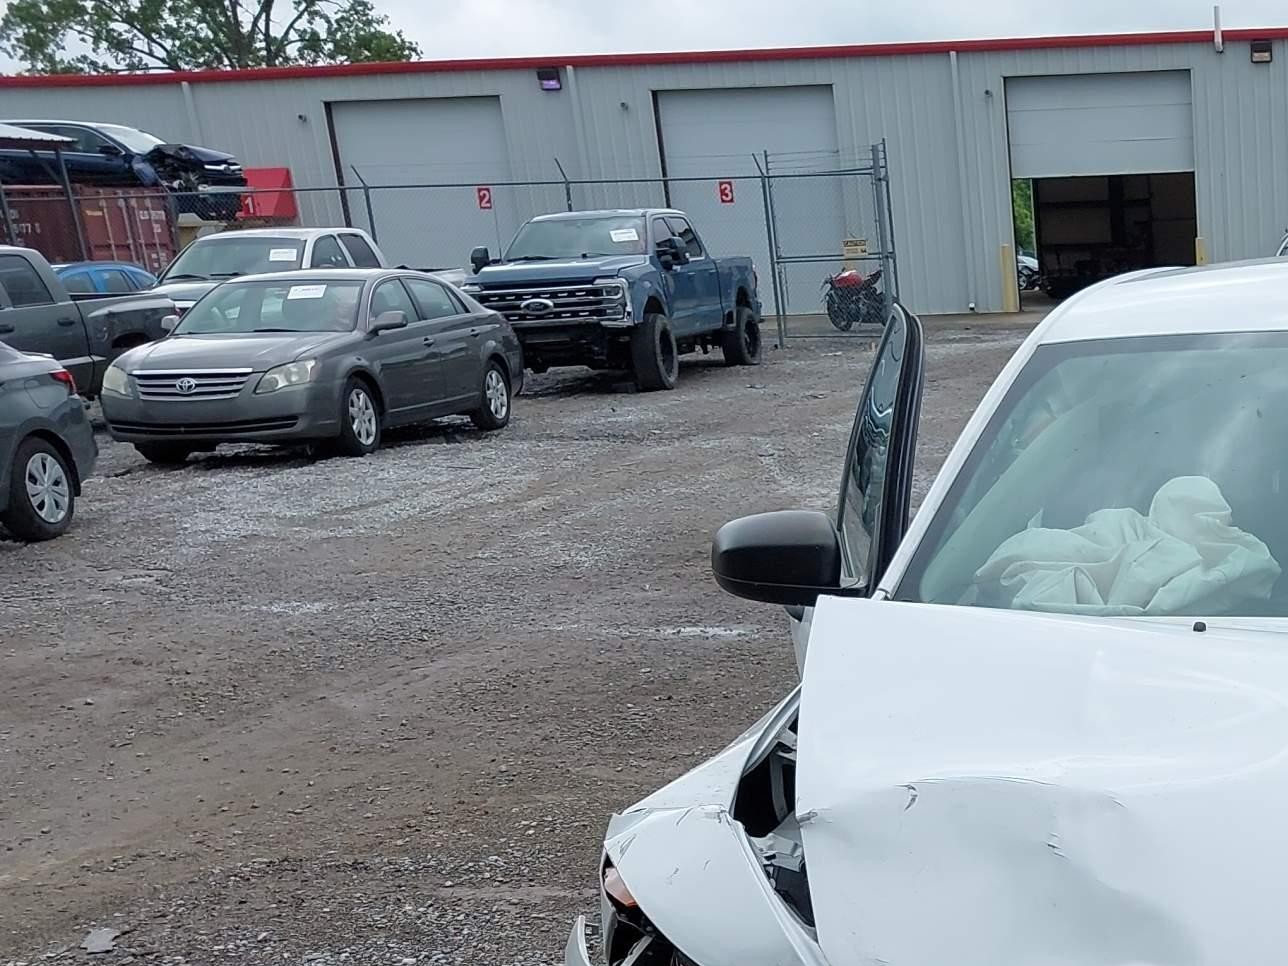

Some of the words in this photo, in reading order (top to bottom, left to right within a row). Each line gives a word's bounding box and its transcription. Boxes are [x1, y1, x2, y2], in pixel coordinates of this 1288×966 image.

[479, 190, 491, 208] 2
[720, 183, 732, 201] 3
[244, 196, 254, 214] 1
